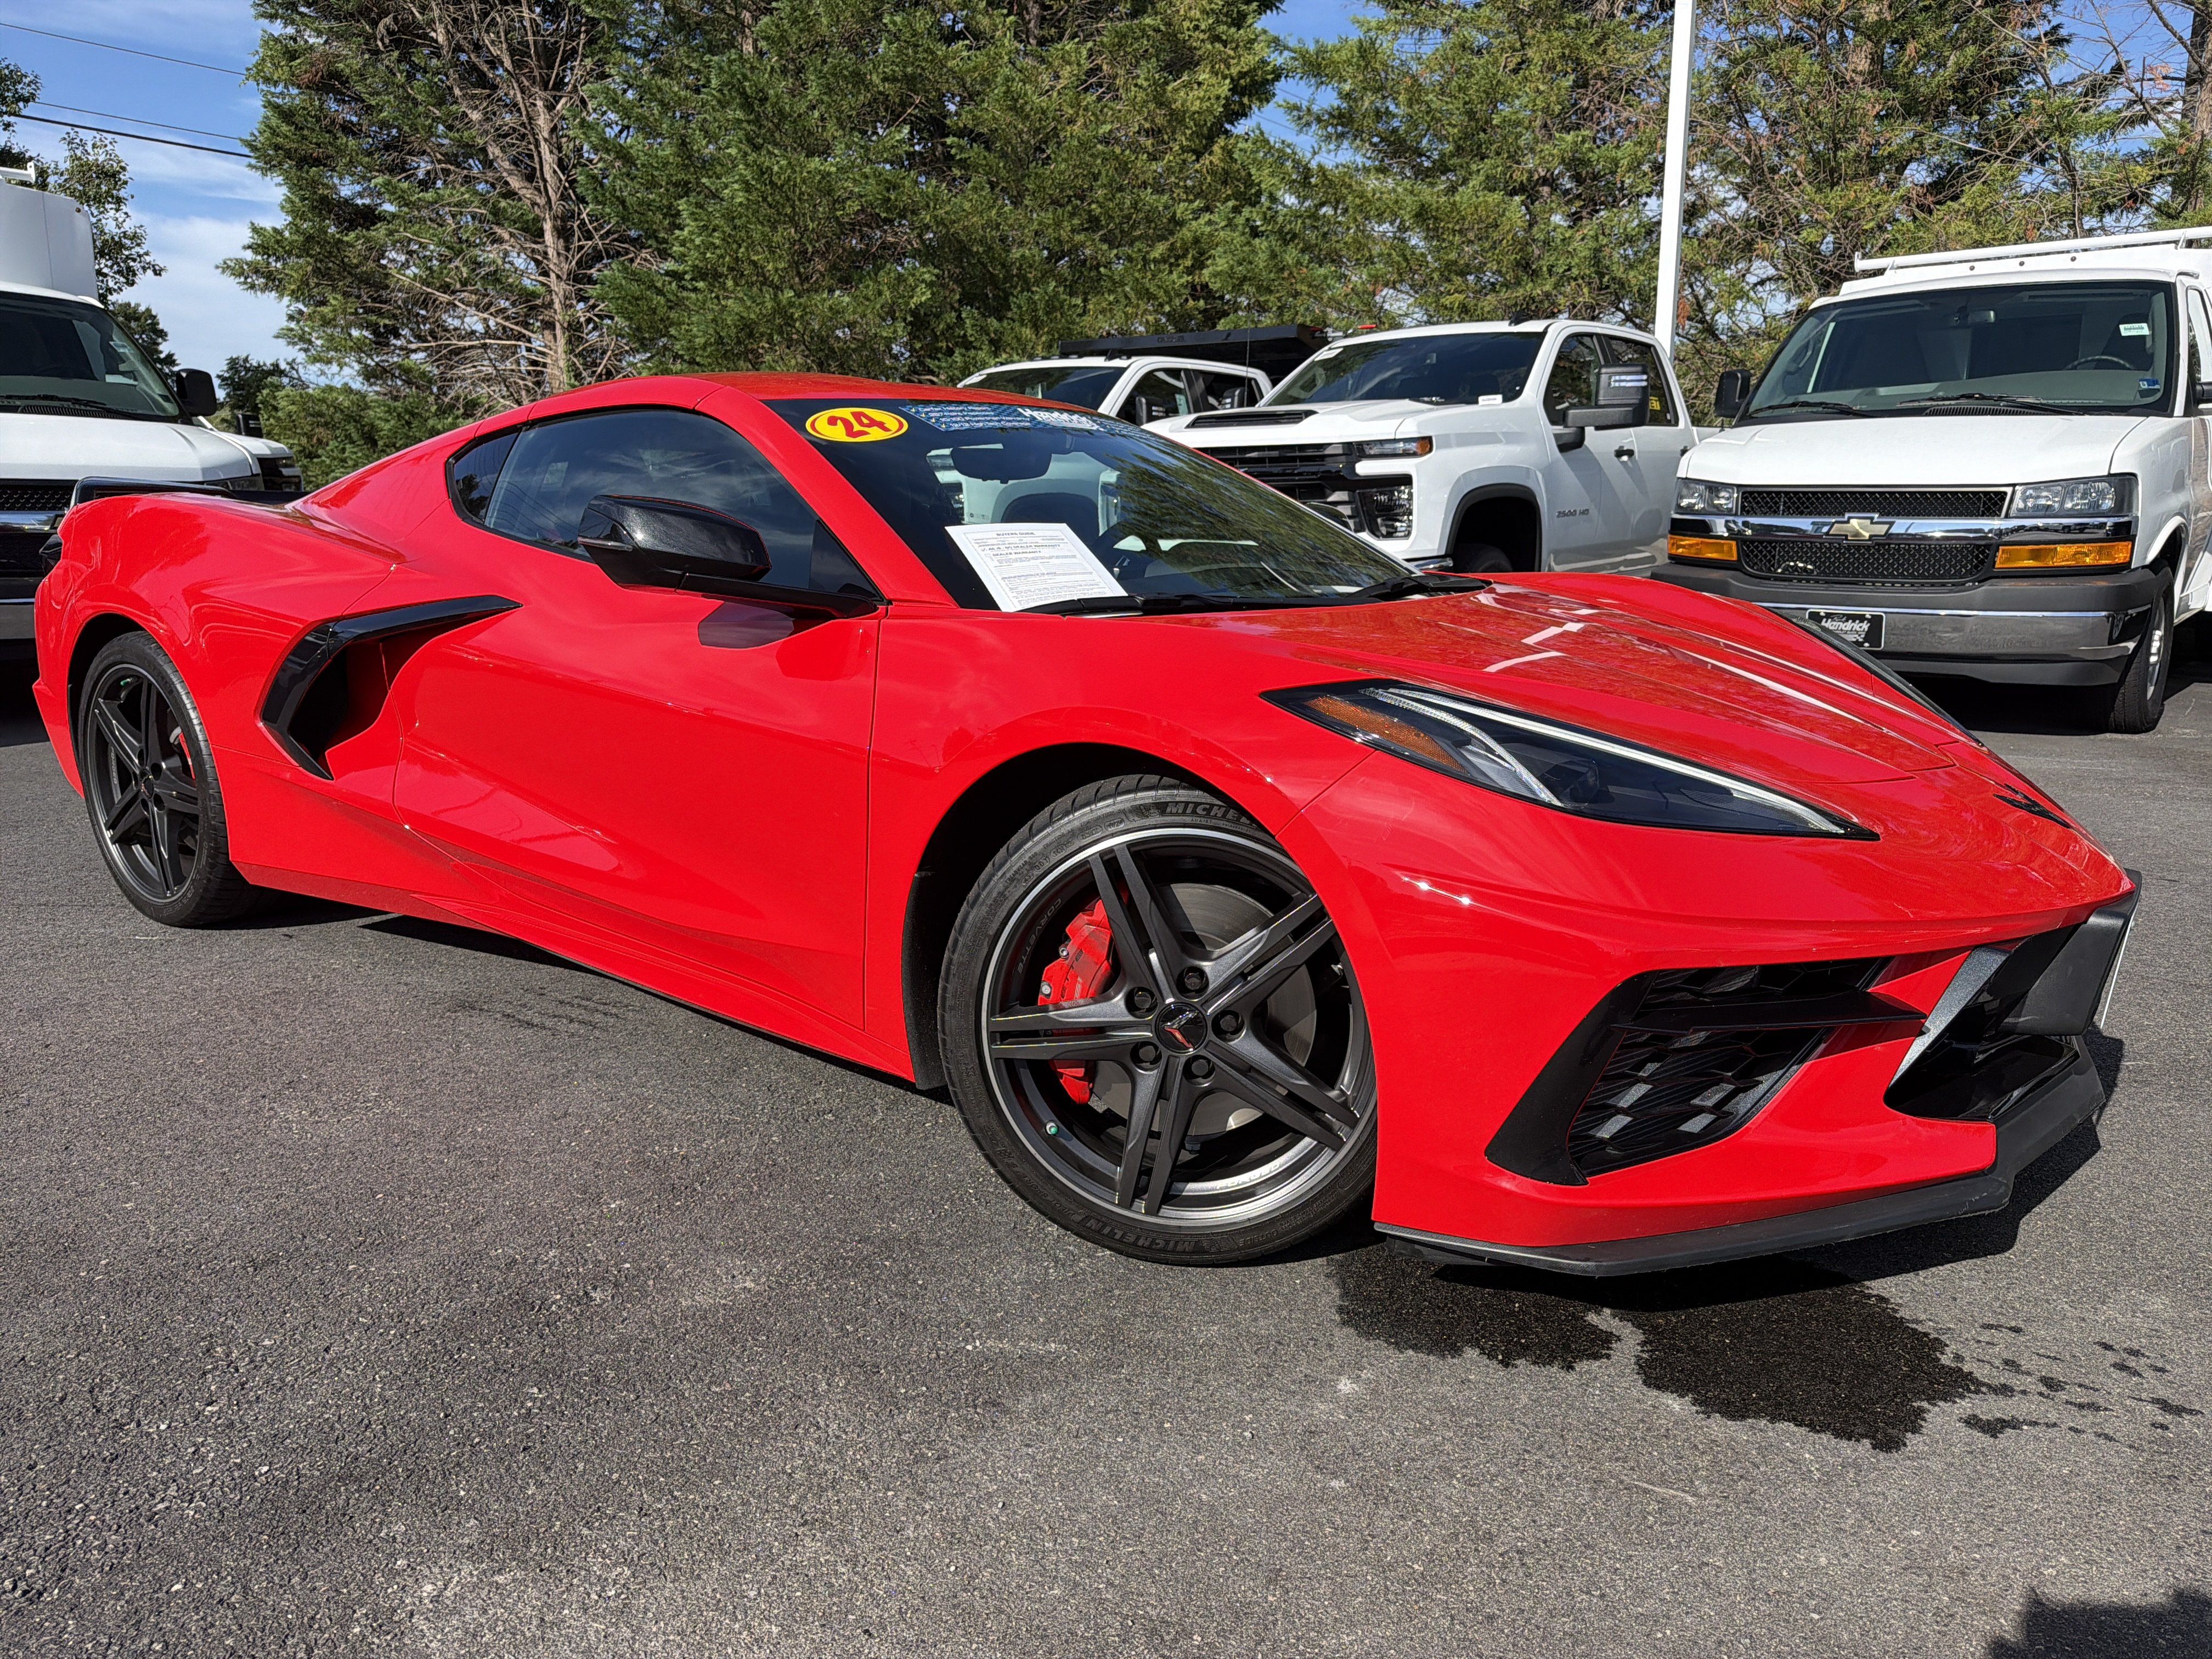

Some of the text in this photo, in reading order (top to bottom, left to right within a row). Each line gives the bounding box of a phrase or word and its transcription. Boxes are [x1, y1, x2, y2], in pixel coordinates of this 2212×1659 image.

[827, 411, 892, 438] 24
[1821, 618, 1871, 631] Hendrick
[1017, 898, 1062, 974] CORVETTE
[1085, 1217, 1195, 1253] MICHELIN
